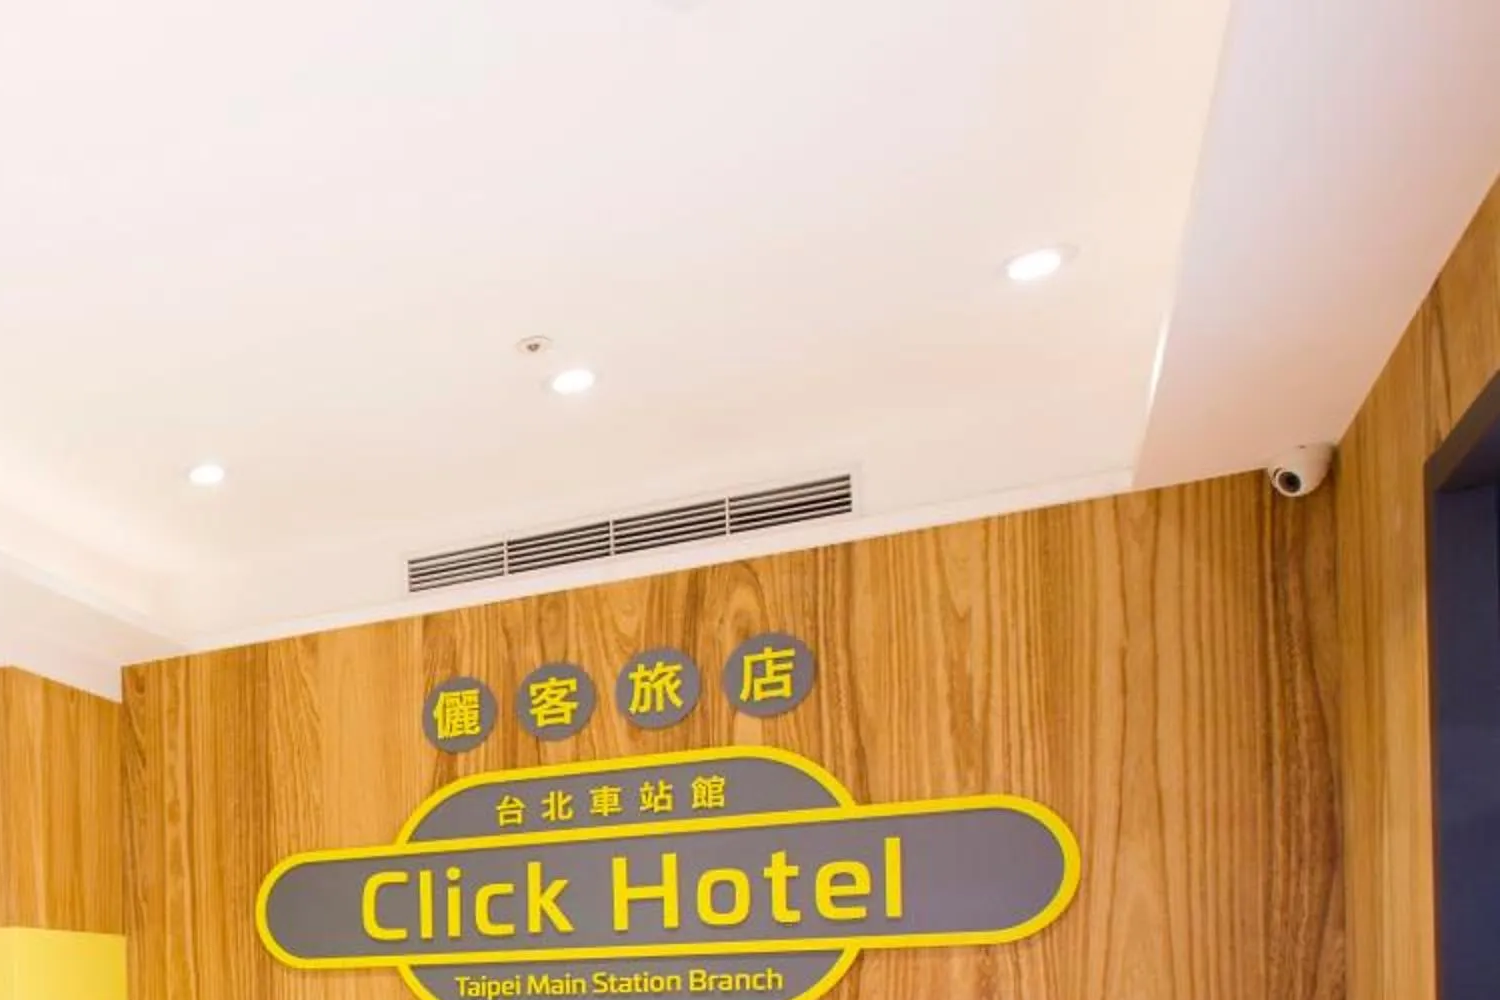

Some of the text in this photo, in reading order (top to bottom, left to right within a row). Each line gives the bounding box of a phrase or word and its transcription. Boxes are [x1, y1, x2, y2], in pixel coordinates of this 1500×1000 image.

[432, 646, 796, 740] 儷客旅店
[495, 775, 726, 827] 台北車站館
[361, 836, 903, 941] Click Hotel
[455, 967, 784, 1000] Taipei Main Station Branch
